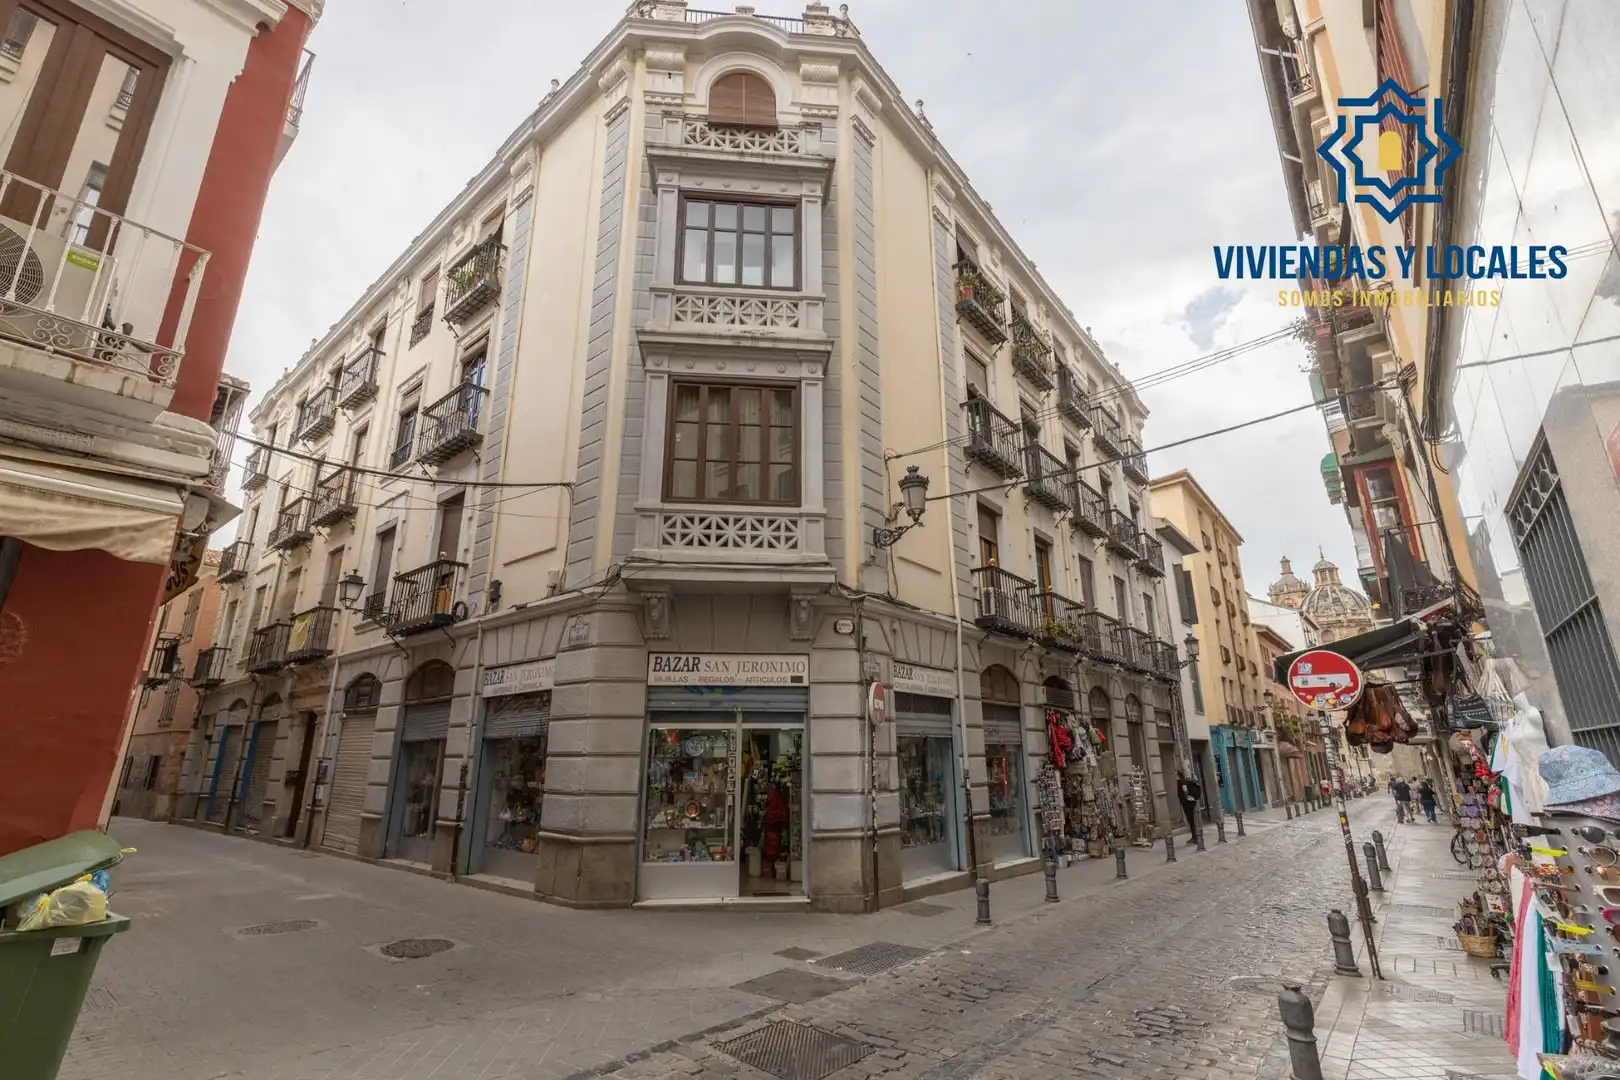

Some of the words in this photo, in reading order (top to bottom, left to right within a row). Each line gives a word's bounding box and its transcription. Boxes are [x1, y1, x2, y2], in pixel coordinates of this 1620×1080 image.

[652, 656, 701, 673] BAZAR
[704, 660, 731, 673] SAN
[735, 660, 806, 676] JERONIMO
[893, 664, 914, 680] BAZAR
[483, 669, 506, 687] BAZAR
[698, 675, 735, 684] REGALOS
[745, 675, 788, 684] ARTICULOS
